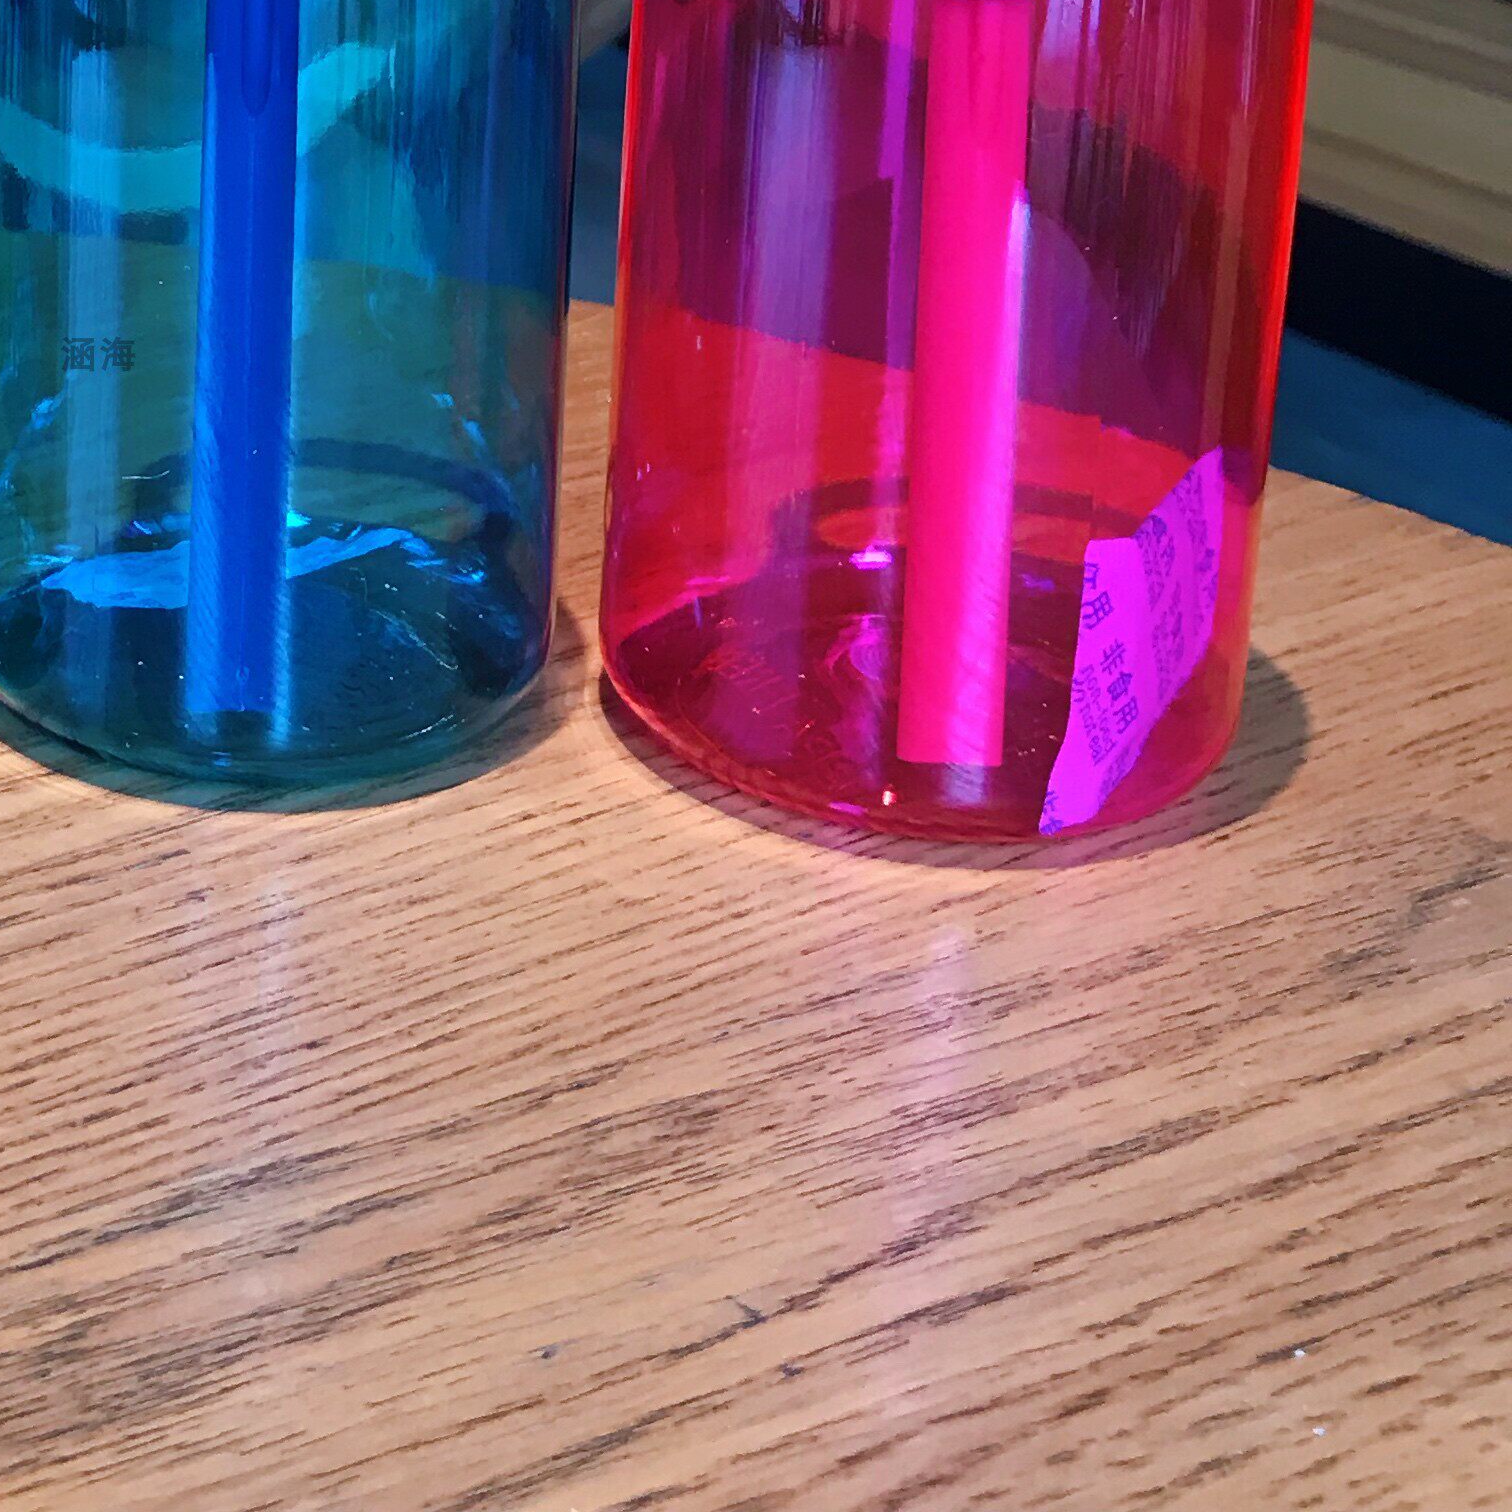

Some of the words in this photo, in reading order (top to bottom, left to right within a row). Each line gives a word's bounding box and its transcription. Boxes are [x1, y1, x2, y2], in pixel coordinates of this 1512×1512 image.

[61, 336, 137, 372] 涵海
[1100, 640, 1141, 735] 非食用
